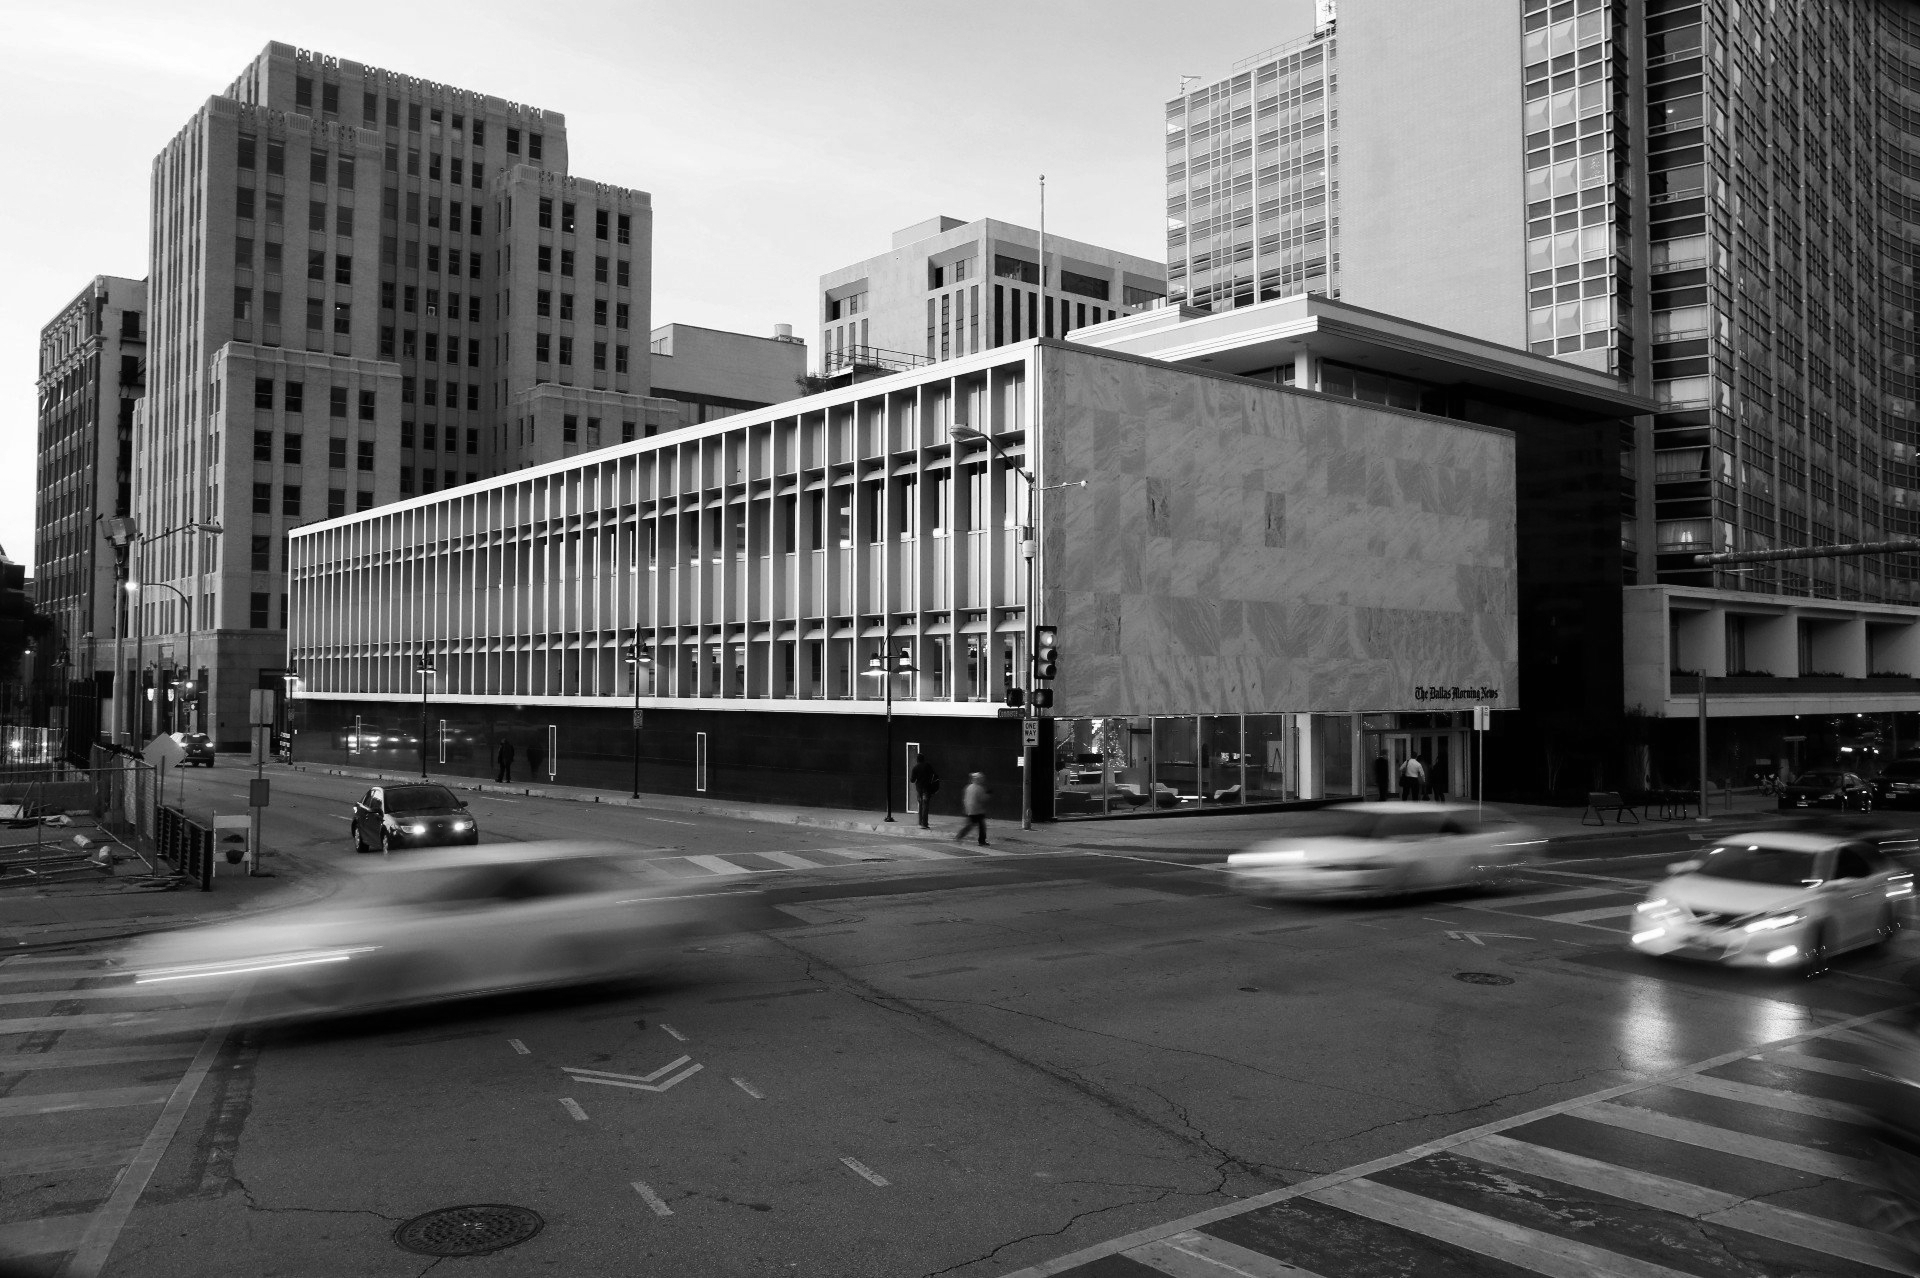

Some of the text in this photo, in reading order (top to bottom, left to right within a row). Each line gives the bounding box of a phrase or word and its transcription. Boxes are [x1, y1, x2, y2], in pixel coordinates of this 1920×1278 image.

[1415, 687, 1498, 701] The Dallas Morning News
